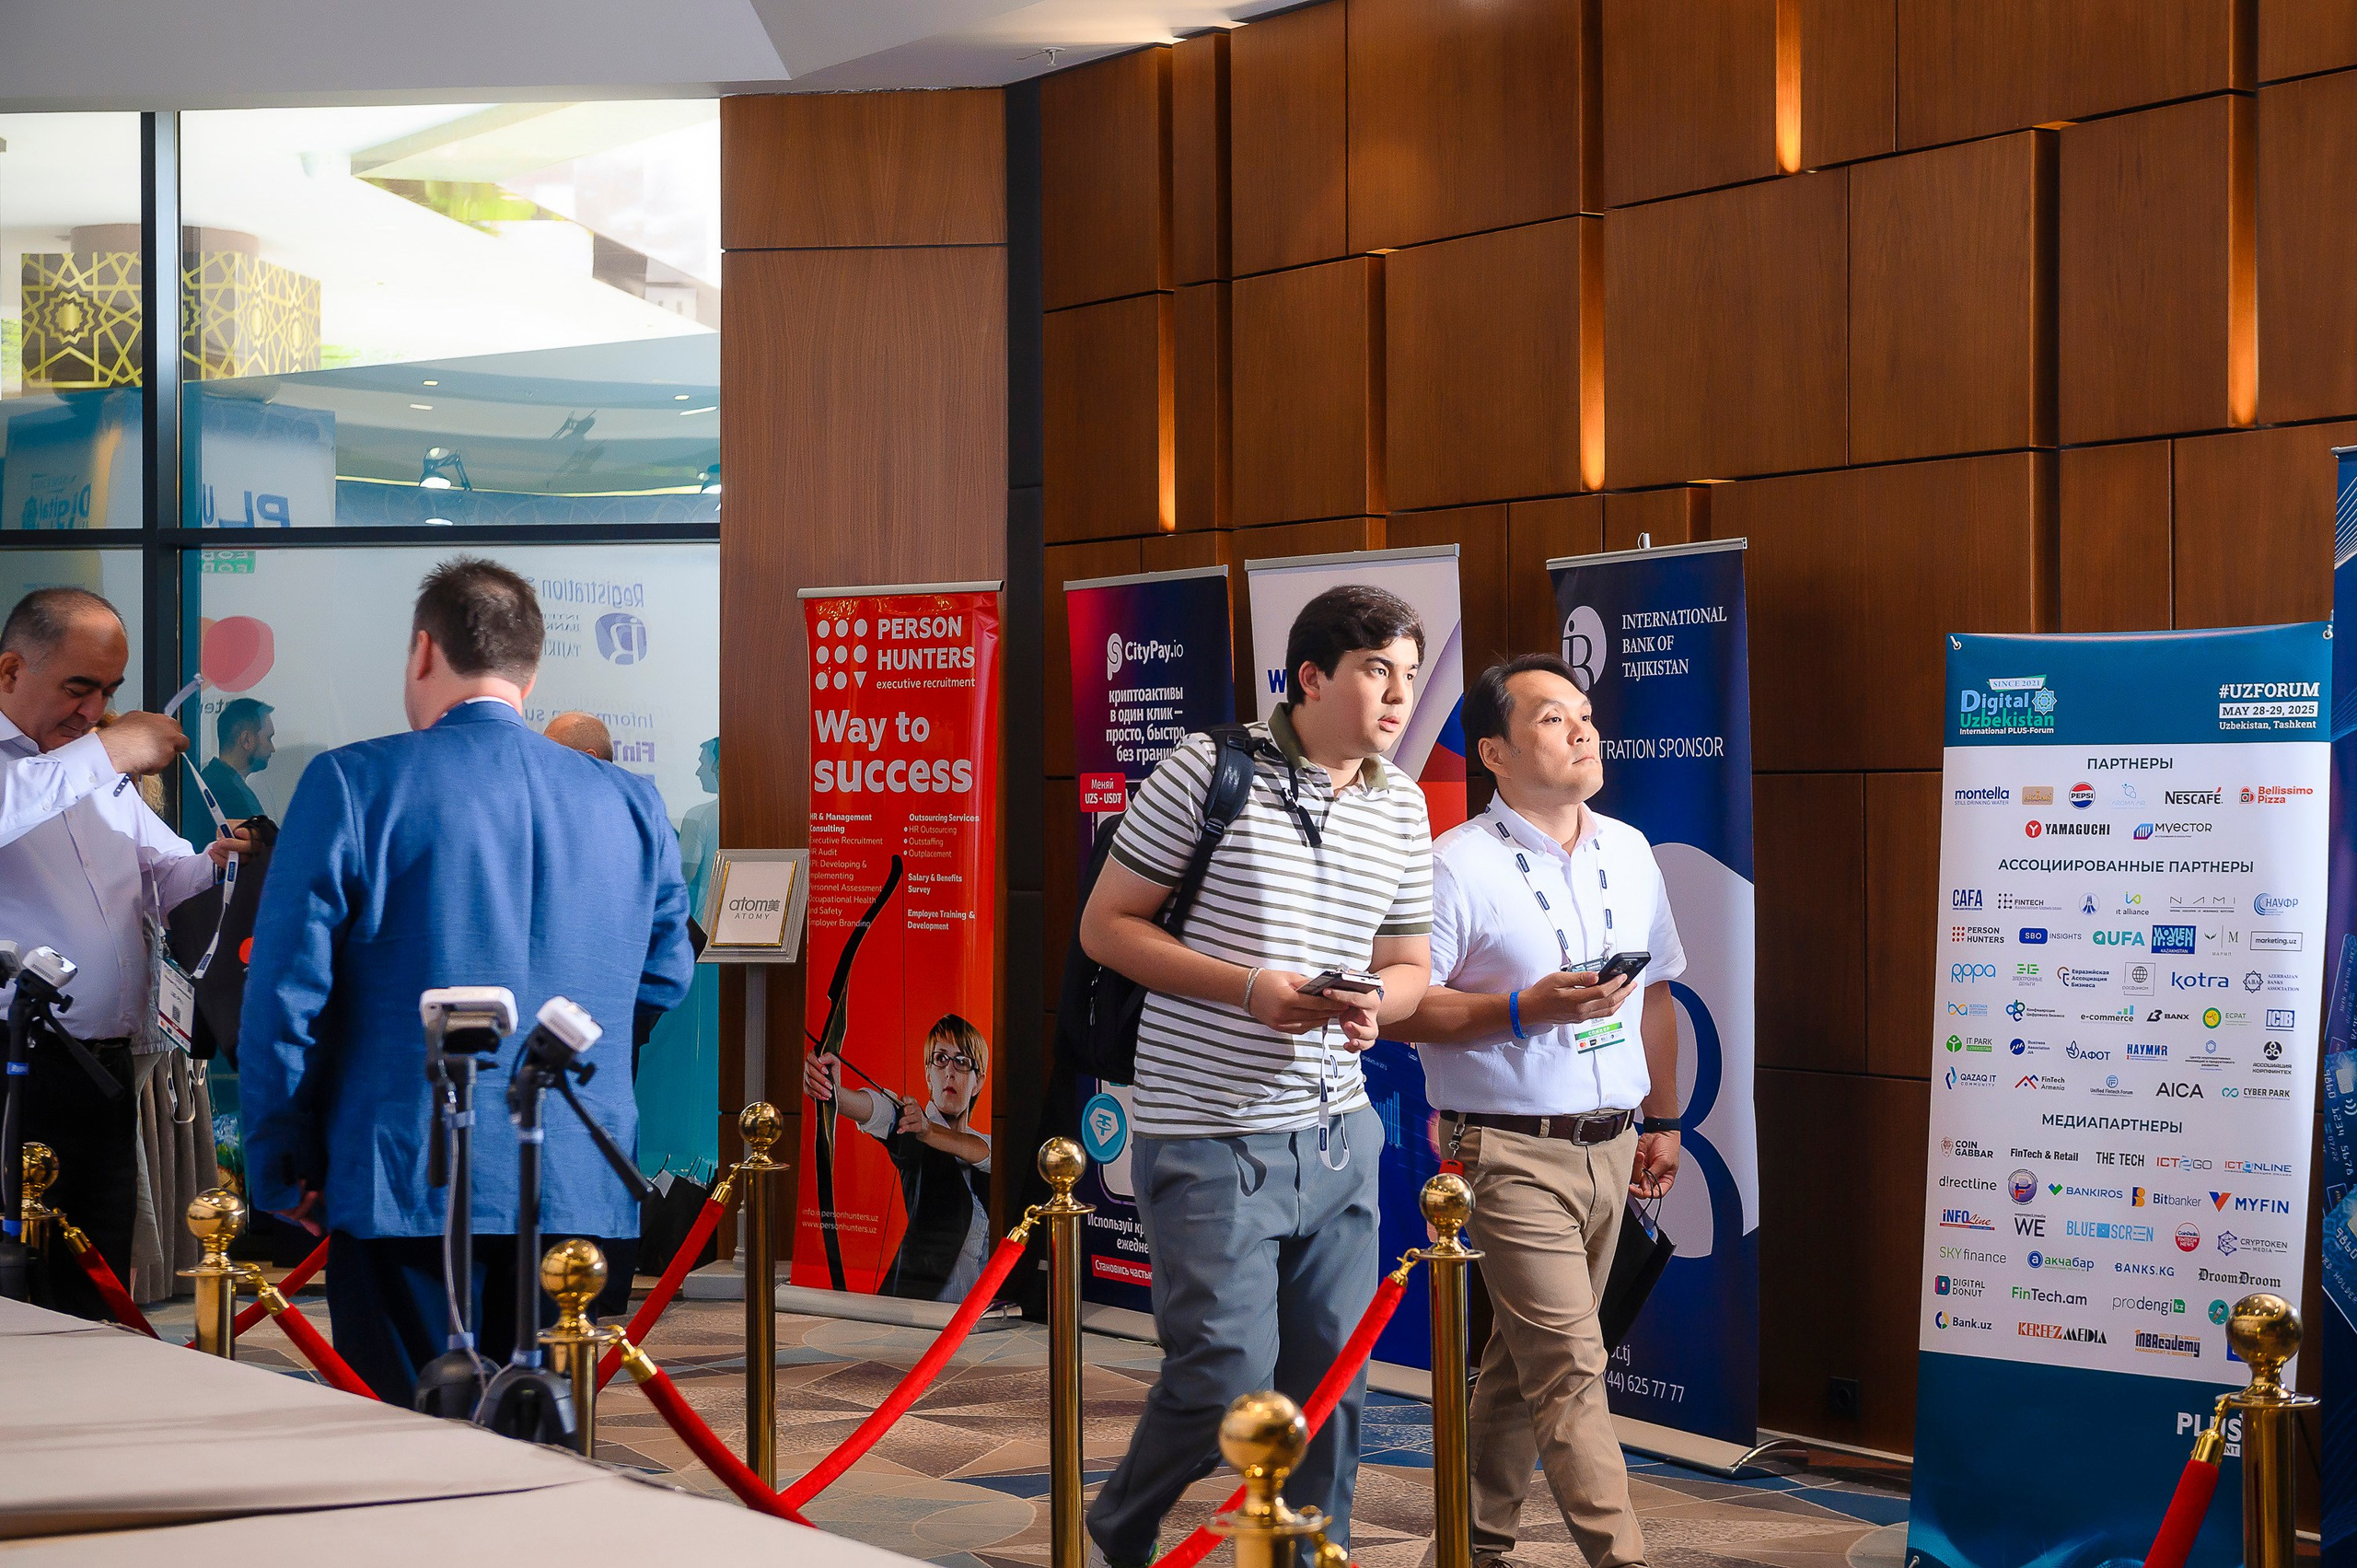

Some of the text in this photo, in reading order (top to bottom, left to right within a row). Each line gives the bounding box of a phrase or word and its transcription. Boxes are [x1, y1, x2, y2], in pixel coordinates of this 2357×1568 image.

[1621, 606, 1727, 630] INTERNATIONAL
[877, 616, 962, 640] PERSON
[1621, 635, 1674, 654] BANK OF
[877, 646, 976, 670] HUNTERS
[1124, 639, 1184, 664] CityPay.io
[1621, 658, 1689, 681] TAJIKISTAN
[877, 677, 976, 690] executive recruitment
[2219, 681, 2320, 699] #UZFORUM
[1109, 686, 1183, 706] криптоактивы
[1960, 690, 2029, 715] Digital
[1109, 705, 1173, 725] в один клик
[2222, 704, 2315, 716] MAY 28-29, 2025
[1960, 707, 2055, 728] Uzbekistan
[815, 709, 930, 751] Way to
[1959, 726, 2054, 736] International PLUS-Forum
[2219, 719, 2316, 730] Uzbekistan, Tashkent
[1106, 724, 1185, 745] просто, быстро
[1116, 745, 1176, 765] без грани
[1599, 737, 1724, 760] TRATION SPONSOR
[2086, 757, 2174, 771] ПАРТНЕРЫ
[814, 759, 973, 794] success
[1091, 778, 1114, 790] Меняй
[2258, 785, 2314, 796] Bellissimo
[1085, 793, 1098, 804] UZS
[1955, 785, 2010, 800] montella
[2258, 796, 2286, 804] Pizza
[819, 813, 872, 822] & Management
[909, 813, 980, 823] Outsourcing Services
[809, 825, 845, 834] Consulting
[909, 825, 957, 835] HR Outsourcing
[2045, 823, 2110, 836] YAMAGUCHI
[842, 836, 883, 845] Recruitment
[909, 837, 944, 846] Outstaffing
[908, 849, 952, 858] Outplacement
[819, 860, 861, 869] Developing
[1998, 858, 2254, 875] АССОЦИИРОВАННЫЕ ПАРТНЕРЫ
[908, 874, 963, 883] Salary & Benefits
[841, 883, 882, 892] Assessment
[908, 885, 931, 895] Survey
[853, 896, 877, 904] Health
[1952, 889, 1983, 907] CAFA
[2266, 897, 2299, 908] НАУФР
[819, 907, 842, 916] Safety
[907, 910, 976, 920] Employee Training &
[907, 922, 949, 931] Development
[1968, 926, 2000, 935] PERSON
[1967, 935, 2004, 944] HUNTERS
[2255, 937, 2297, 947] marketing.uz
[2171, 971, 2229, 990] kotra
[2080, 1014, 2134, 1023] e-commerce
[2079, 1051, 2111, 1061] АФОТ
[1960, 1074, 1997, 1083] QAZAQ IT
[2041, 1075, 2065, 1084] FinTech
[2155, 1082, 2204, 1099] AICA
[2243, 1087, 2291, 1098] CYBER PARK
[2041, 1112, 2183, 1134] МЕДИАПАРТНЕРЫ
[1955, 1140, 1978, 1149] COIN
[1955, 1148, 1994, 1159] GABBAR
[2010, 1148, 2079, 1162] FinTech & Retail
[2096, 1151, 2145, 1167] THE TECH
[1938, 1176, 1997, 1191] d!rectline
[2066, 1186, 2123, 1199] BANKIROS
[2153, 1193, 2201, 1207] Bitbanker
[2235, 1197, 2290, 1214] MYFIN
[1087, 1213, 1133, 1234] Используй
[2014, 1217, 2046, 1237] WE
[2240, 1237, 2288, 1249] CRYPTOKEN
[1095, 1260, 1129, 1276] Становись
[2044, 1255, 2095, 1272] акчабар
[1952, 1278, 1986, 1289] DIGITAL
[2198, 1267, 2282, 1288] DroomDroom
[1952, 1287, 1982, 1297] DONUT
[2012, 1286, 2087, 1306] FinTech.am
[1952, 1317, 1992, 1330] Bank.uz
[1627, 1375, 1649, 1395] 625
[1651, 1379, 1666, 1400] 77
[1669, 1384, 1685, 1403] 77
